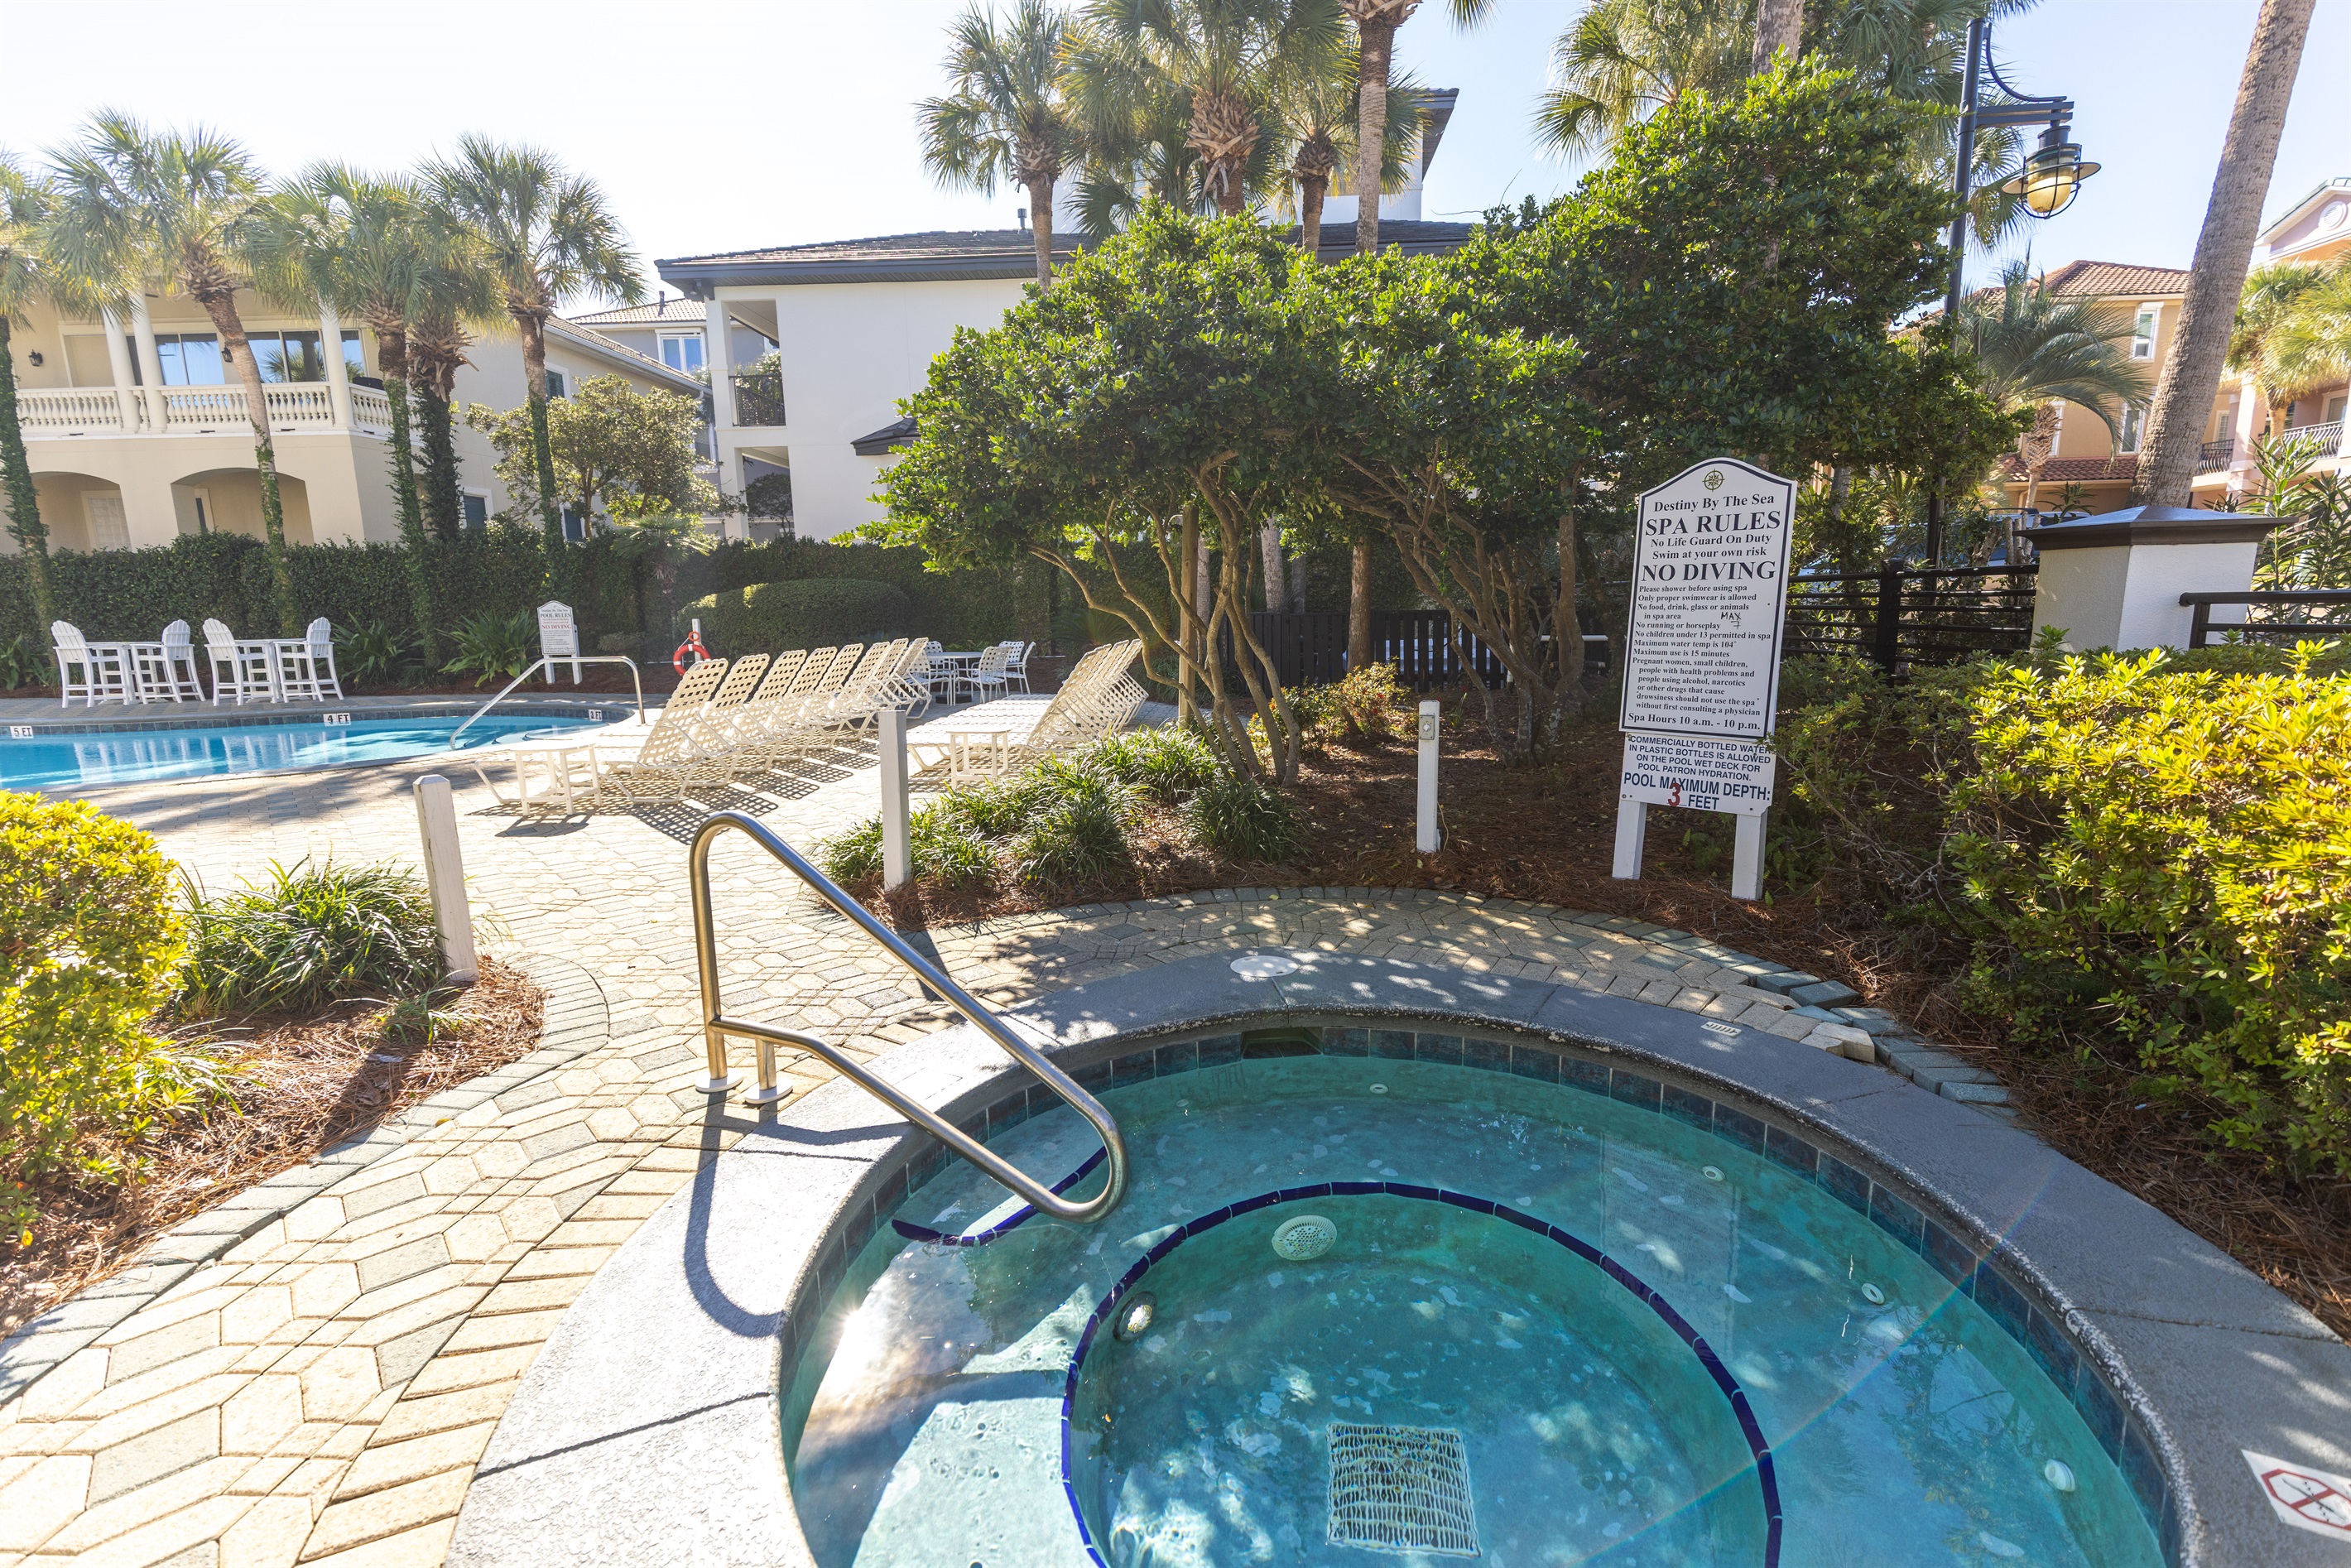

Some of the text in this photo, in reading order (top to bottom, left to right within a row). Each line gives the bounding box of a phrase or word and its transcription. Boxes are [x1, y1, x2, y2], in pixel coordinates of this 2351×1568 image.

[1653, 494, 1774, 512] Destiny By The Sea
[1646, 511, 1781, 536] SPA RULES
[1651, 534, 1772, 547] No Life Guard On Duty
[1652, 551, 1679, 559] Swim
[1695, 550, 1719, 560] your
[1746, 547, 1767, 556] risk
[1642, 561, 1776, 581] NO DIVING
[1720, 612, 1742, 620] MAX
[1709, 632, 1746, 640] permitted
[1714, 660, 1748, 668] children,
[1662, 676, 1680, 685] using
[1712, 678, 1745, 686] narcotics
[1637, 693, 1674, 701] drowsiness
[1676, 695, 1699, 703] should
[1680, 705, 1716, 714] consulting
[1724, 707, 1761, 715] physician
[328, 715, 334, 724] 4
[1628, 713, 1645, 722] Spa
[1647, 714, 1676, 724] Hours
[1680, 716, 1690, 724] 10
[1693, 718, 1714, 726] a.m.
[1724, 719, 1735, 728] 10
[1738, 720, 1761, 730] p.m.
[1631, 735, 1695, 748] COMMERCIALLY
[1697, 741, 1738, 752] BOTTLED
[1640, 746, 1674, 755] PLASTIC
[1676, 748, 1714, 759] BOTTLES
[1727, 753, 1771, 763] ALLOWED
[1651, 755, 1667, 763] THE
[1669, 757, 1692, 766] POOL
[1695, 759, 1713, 767] WET
[1715, 762, 1739, 771] DECK
[1742, 763, 1761, 772] FOR
[1638, 763, 1752, 782] POOL PATRON HYDRATION.
[1623, 772, 1771, 801] POOL MAXIMUM DEPTH:
[1668, 782, 1719, 810] 3 FEET
